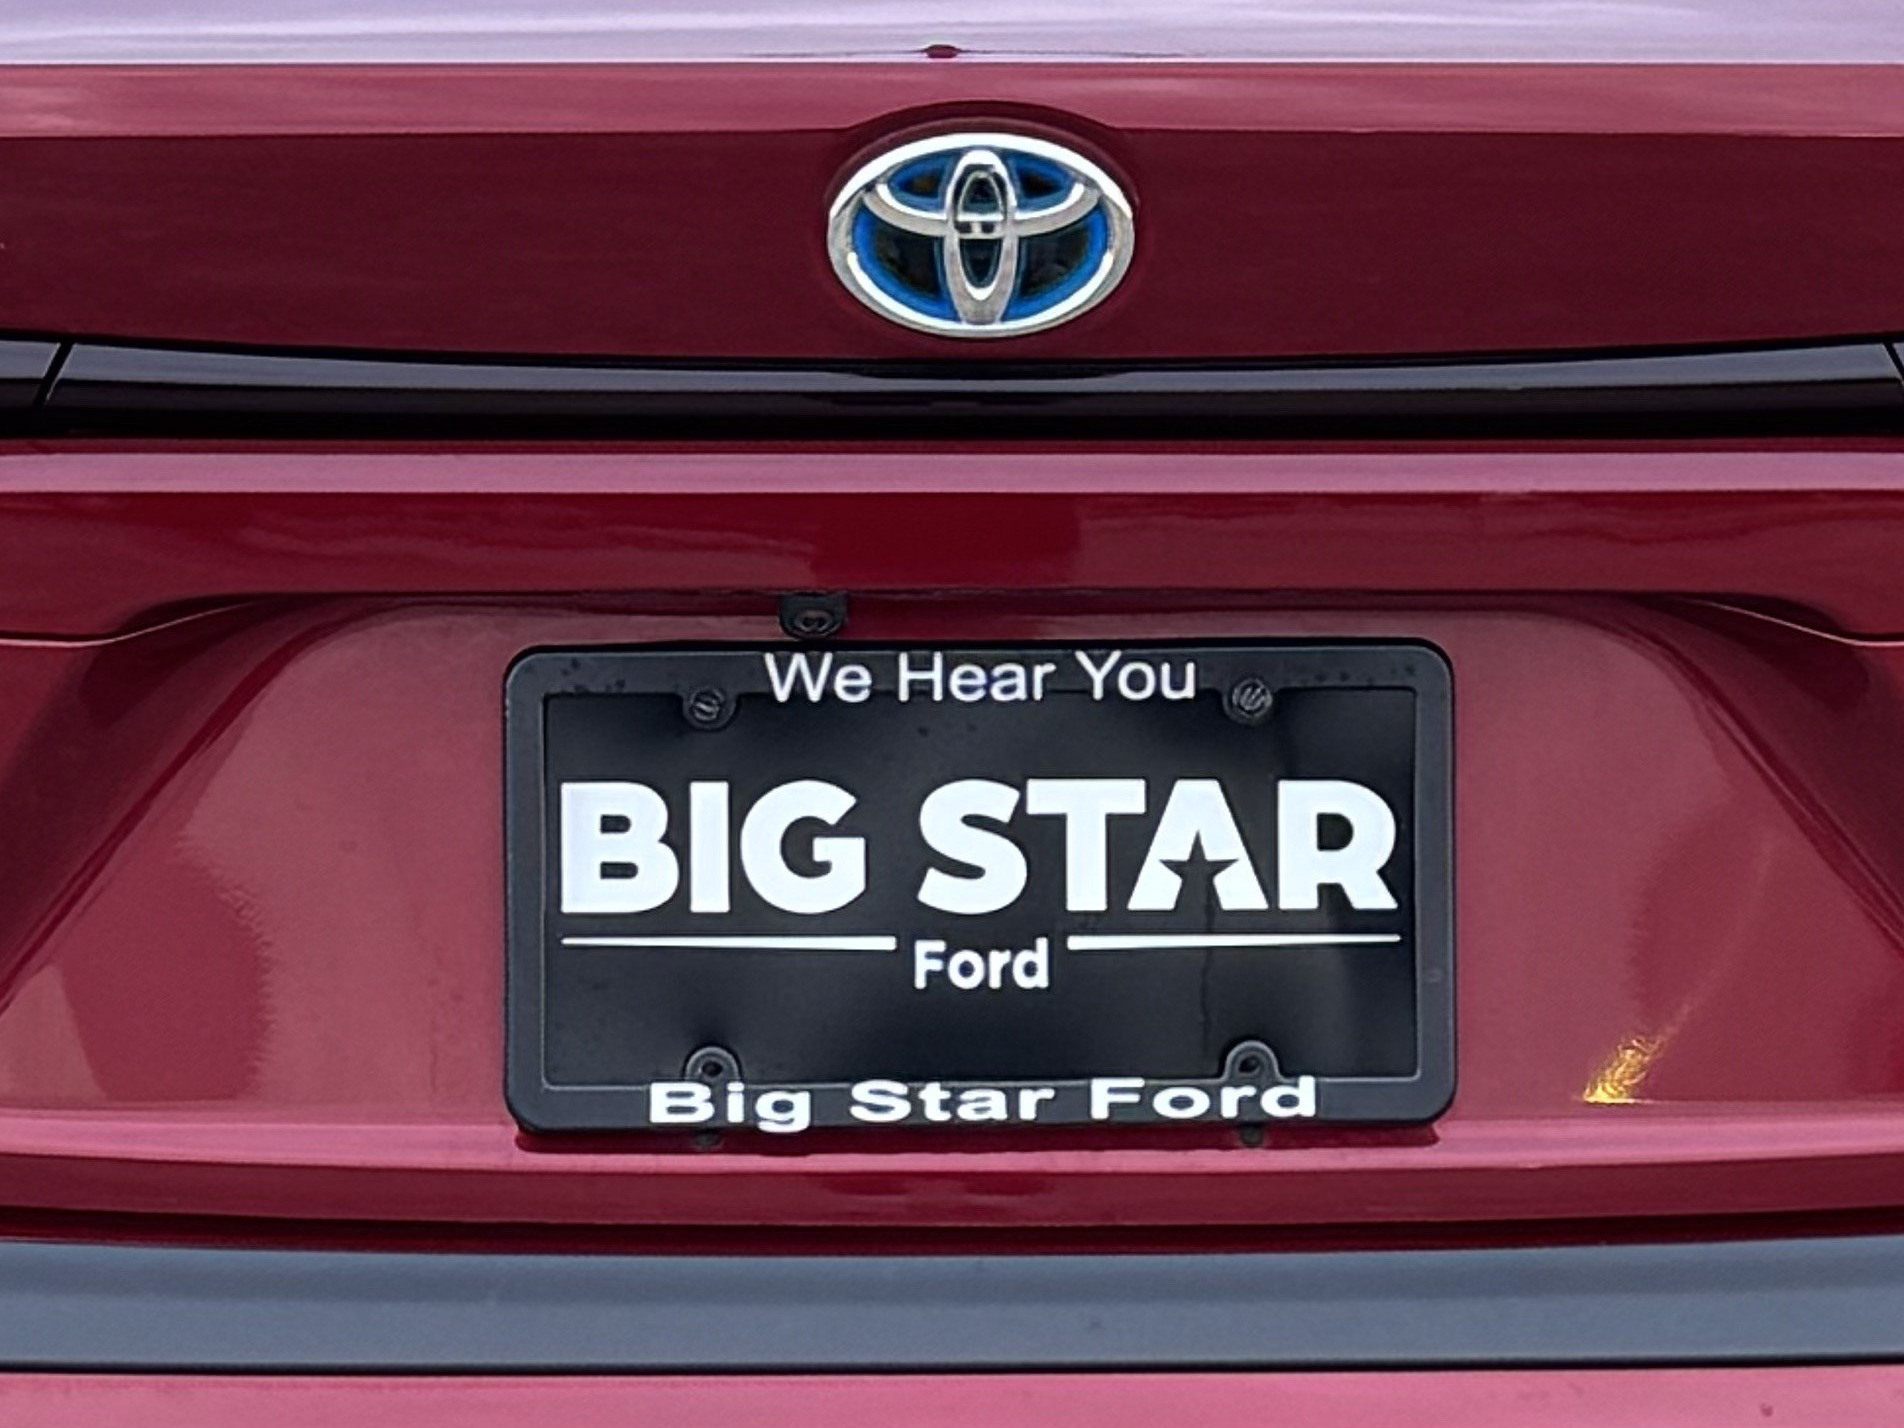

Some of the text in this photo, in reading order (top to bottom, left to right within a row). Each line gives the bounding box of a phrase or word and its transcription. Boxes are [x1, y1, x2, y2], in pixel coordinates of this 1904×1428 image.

[764, 650, 1196, 703] We Hear You
[560, 778, 1398, 915] BIG STAR
[914, 937, 1049, 990] Ford
[649, 1075, 1317, 1133] Big Star Ford
